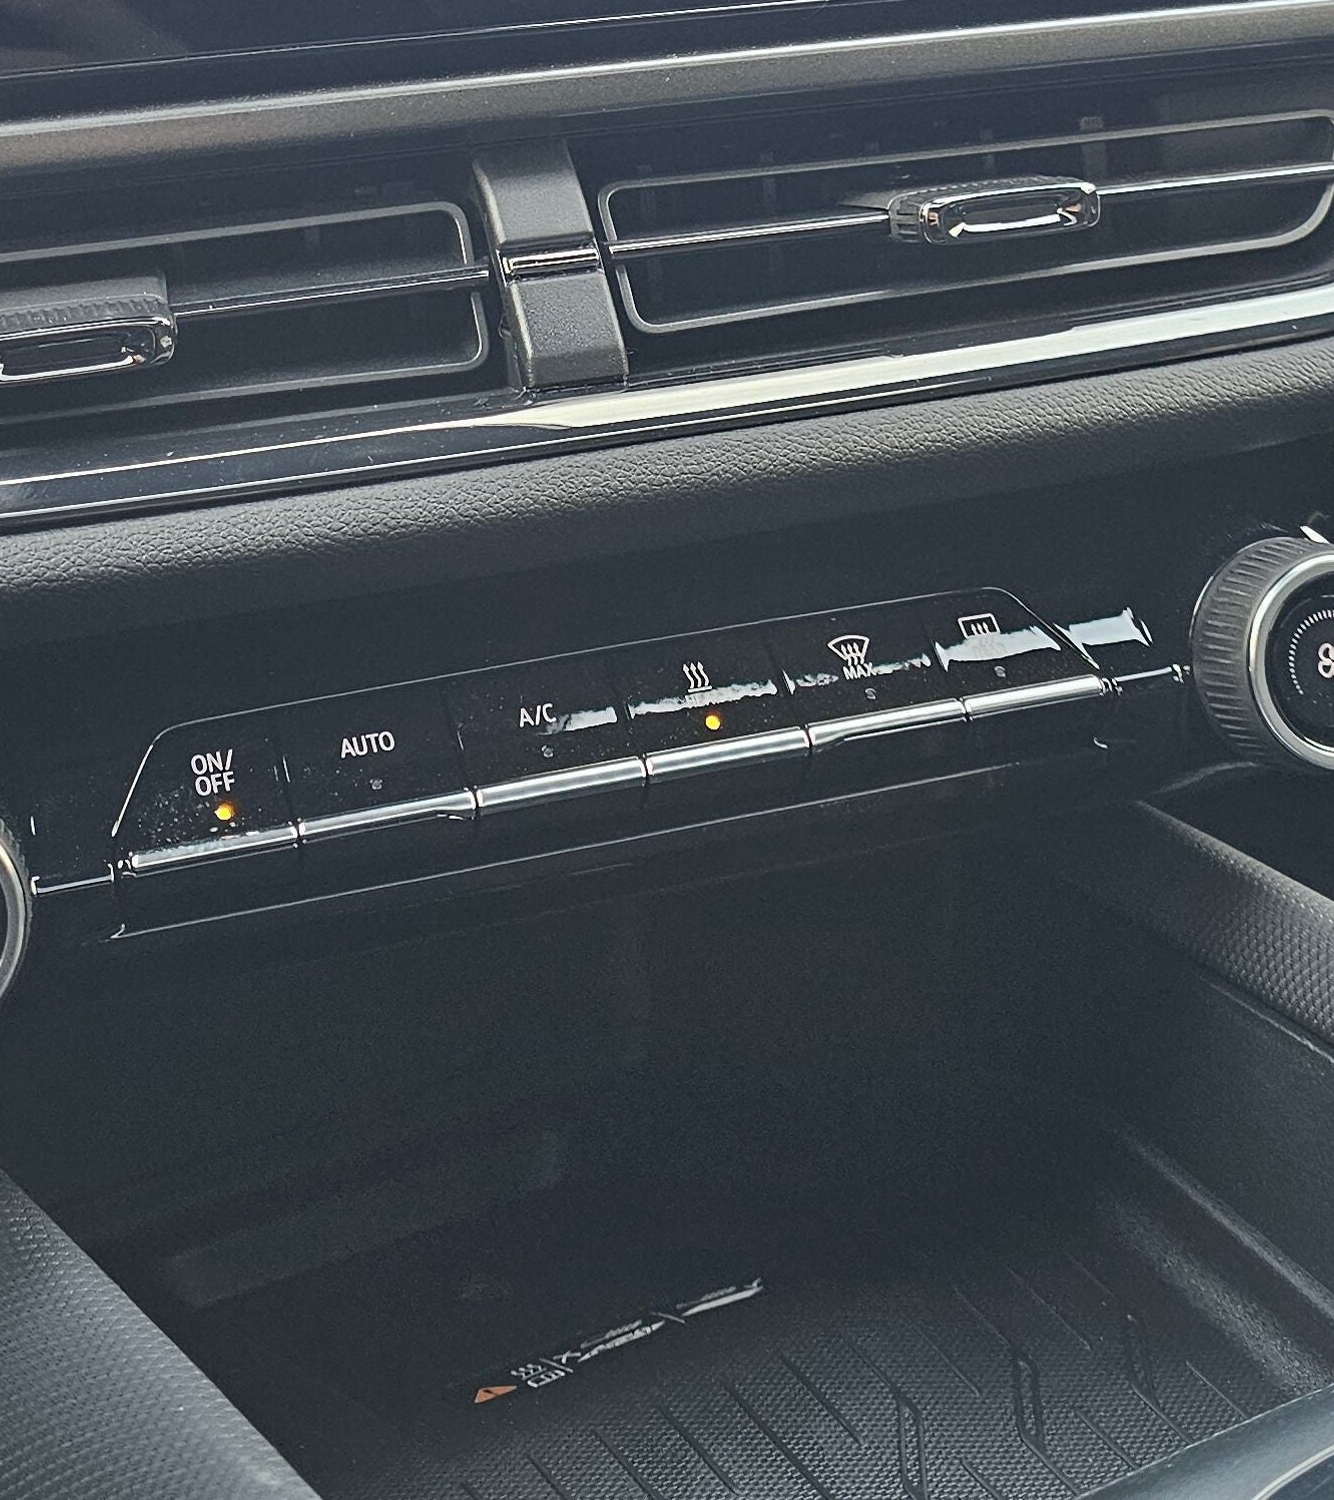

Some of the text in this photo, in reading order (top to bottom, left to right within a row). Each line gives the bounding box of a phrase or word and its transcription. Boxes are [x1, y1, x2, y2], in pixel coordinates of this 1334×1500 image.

[842, 661, 877, 680] MAX
[519, 702, 557, 728] A/C
[340, 731, 395, 759] AUTO
[190, 748, 233, 775] ON/
[194, 770, 235, 797] OFF
